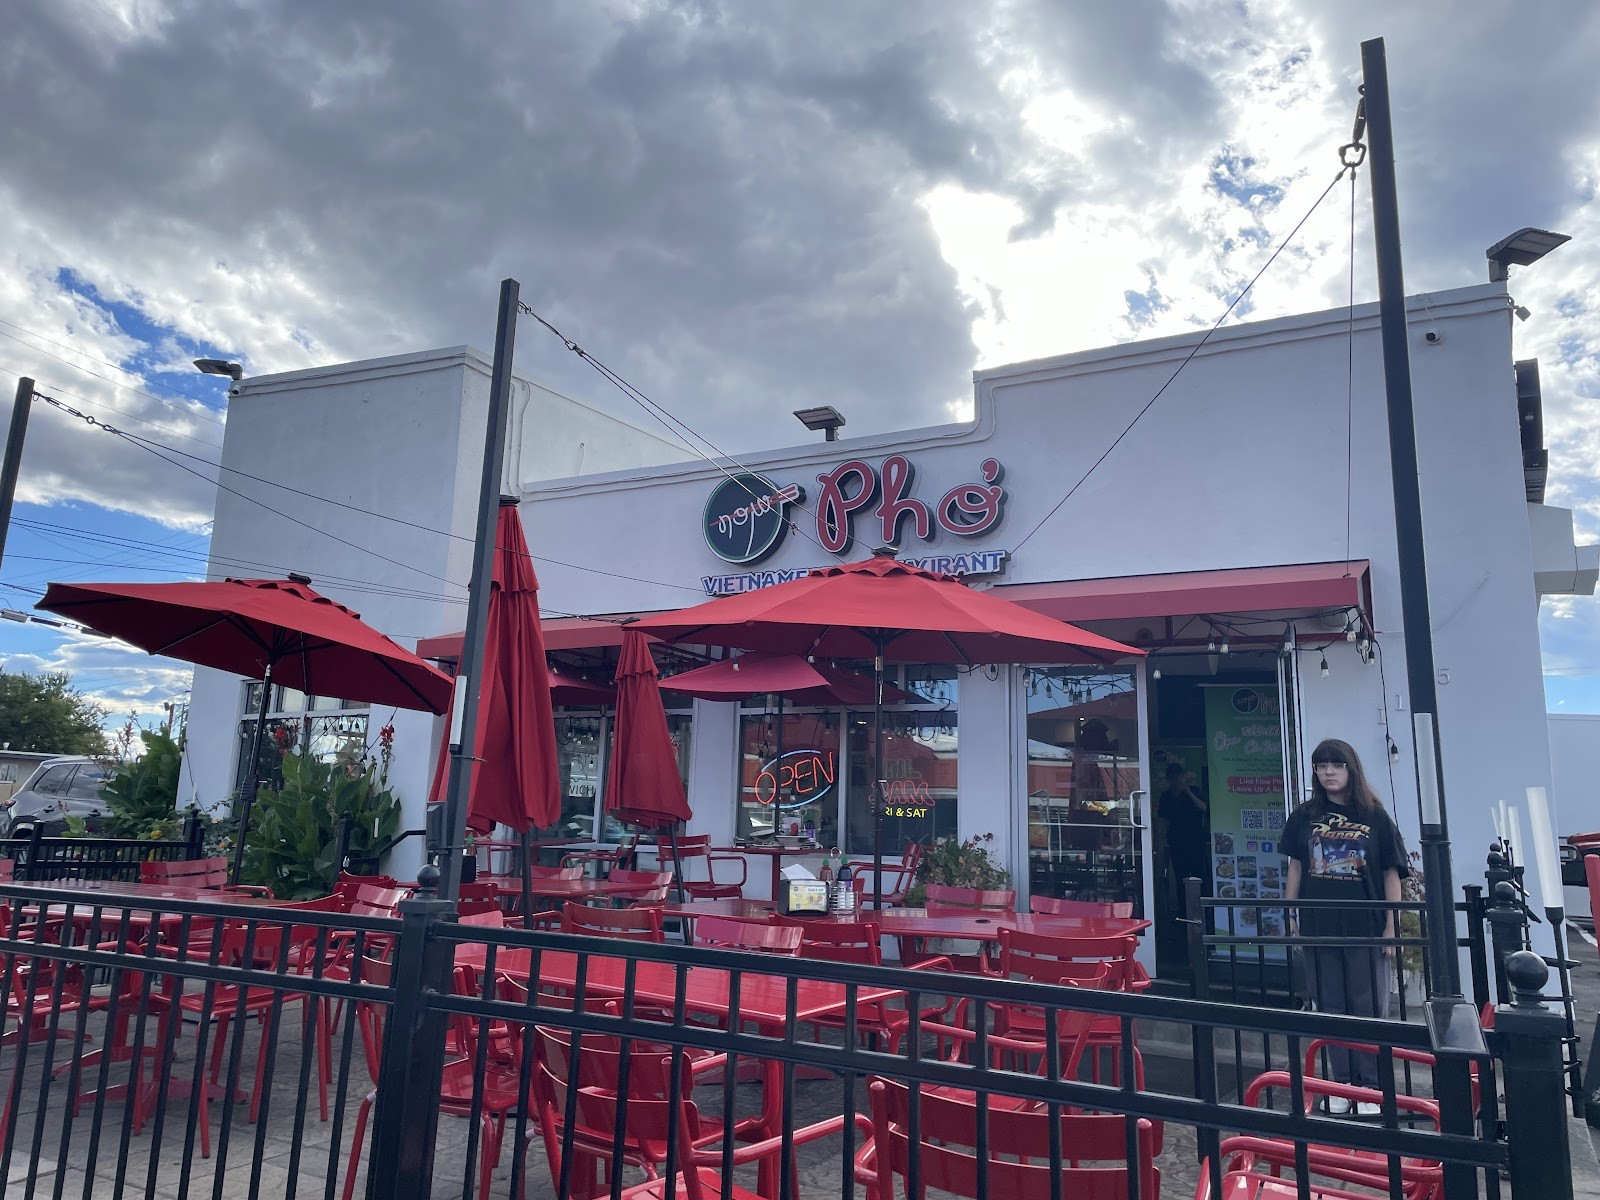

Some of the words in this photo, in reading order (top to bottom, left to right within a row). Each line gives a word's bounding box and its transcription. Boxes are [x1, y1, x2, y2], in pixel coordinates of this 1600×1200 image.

[703, 569, 808, 593] VIETNAM
[755, 752, 834, 804] OPEN
[1239, 777, 1254, 785] Like
[895, 807, 904, 817] &
[906, 807, 928, 818] SAT
[1327, 812, 1371, 834] Pizza
